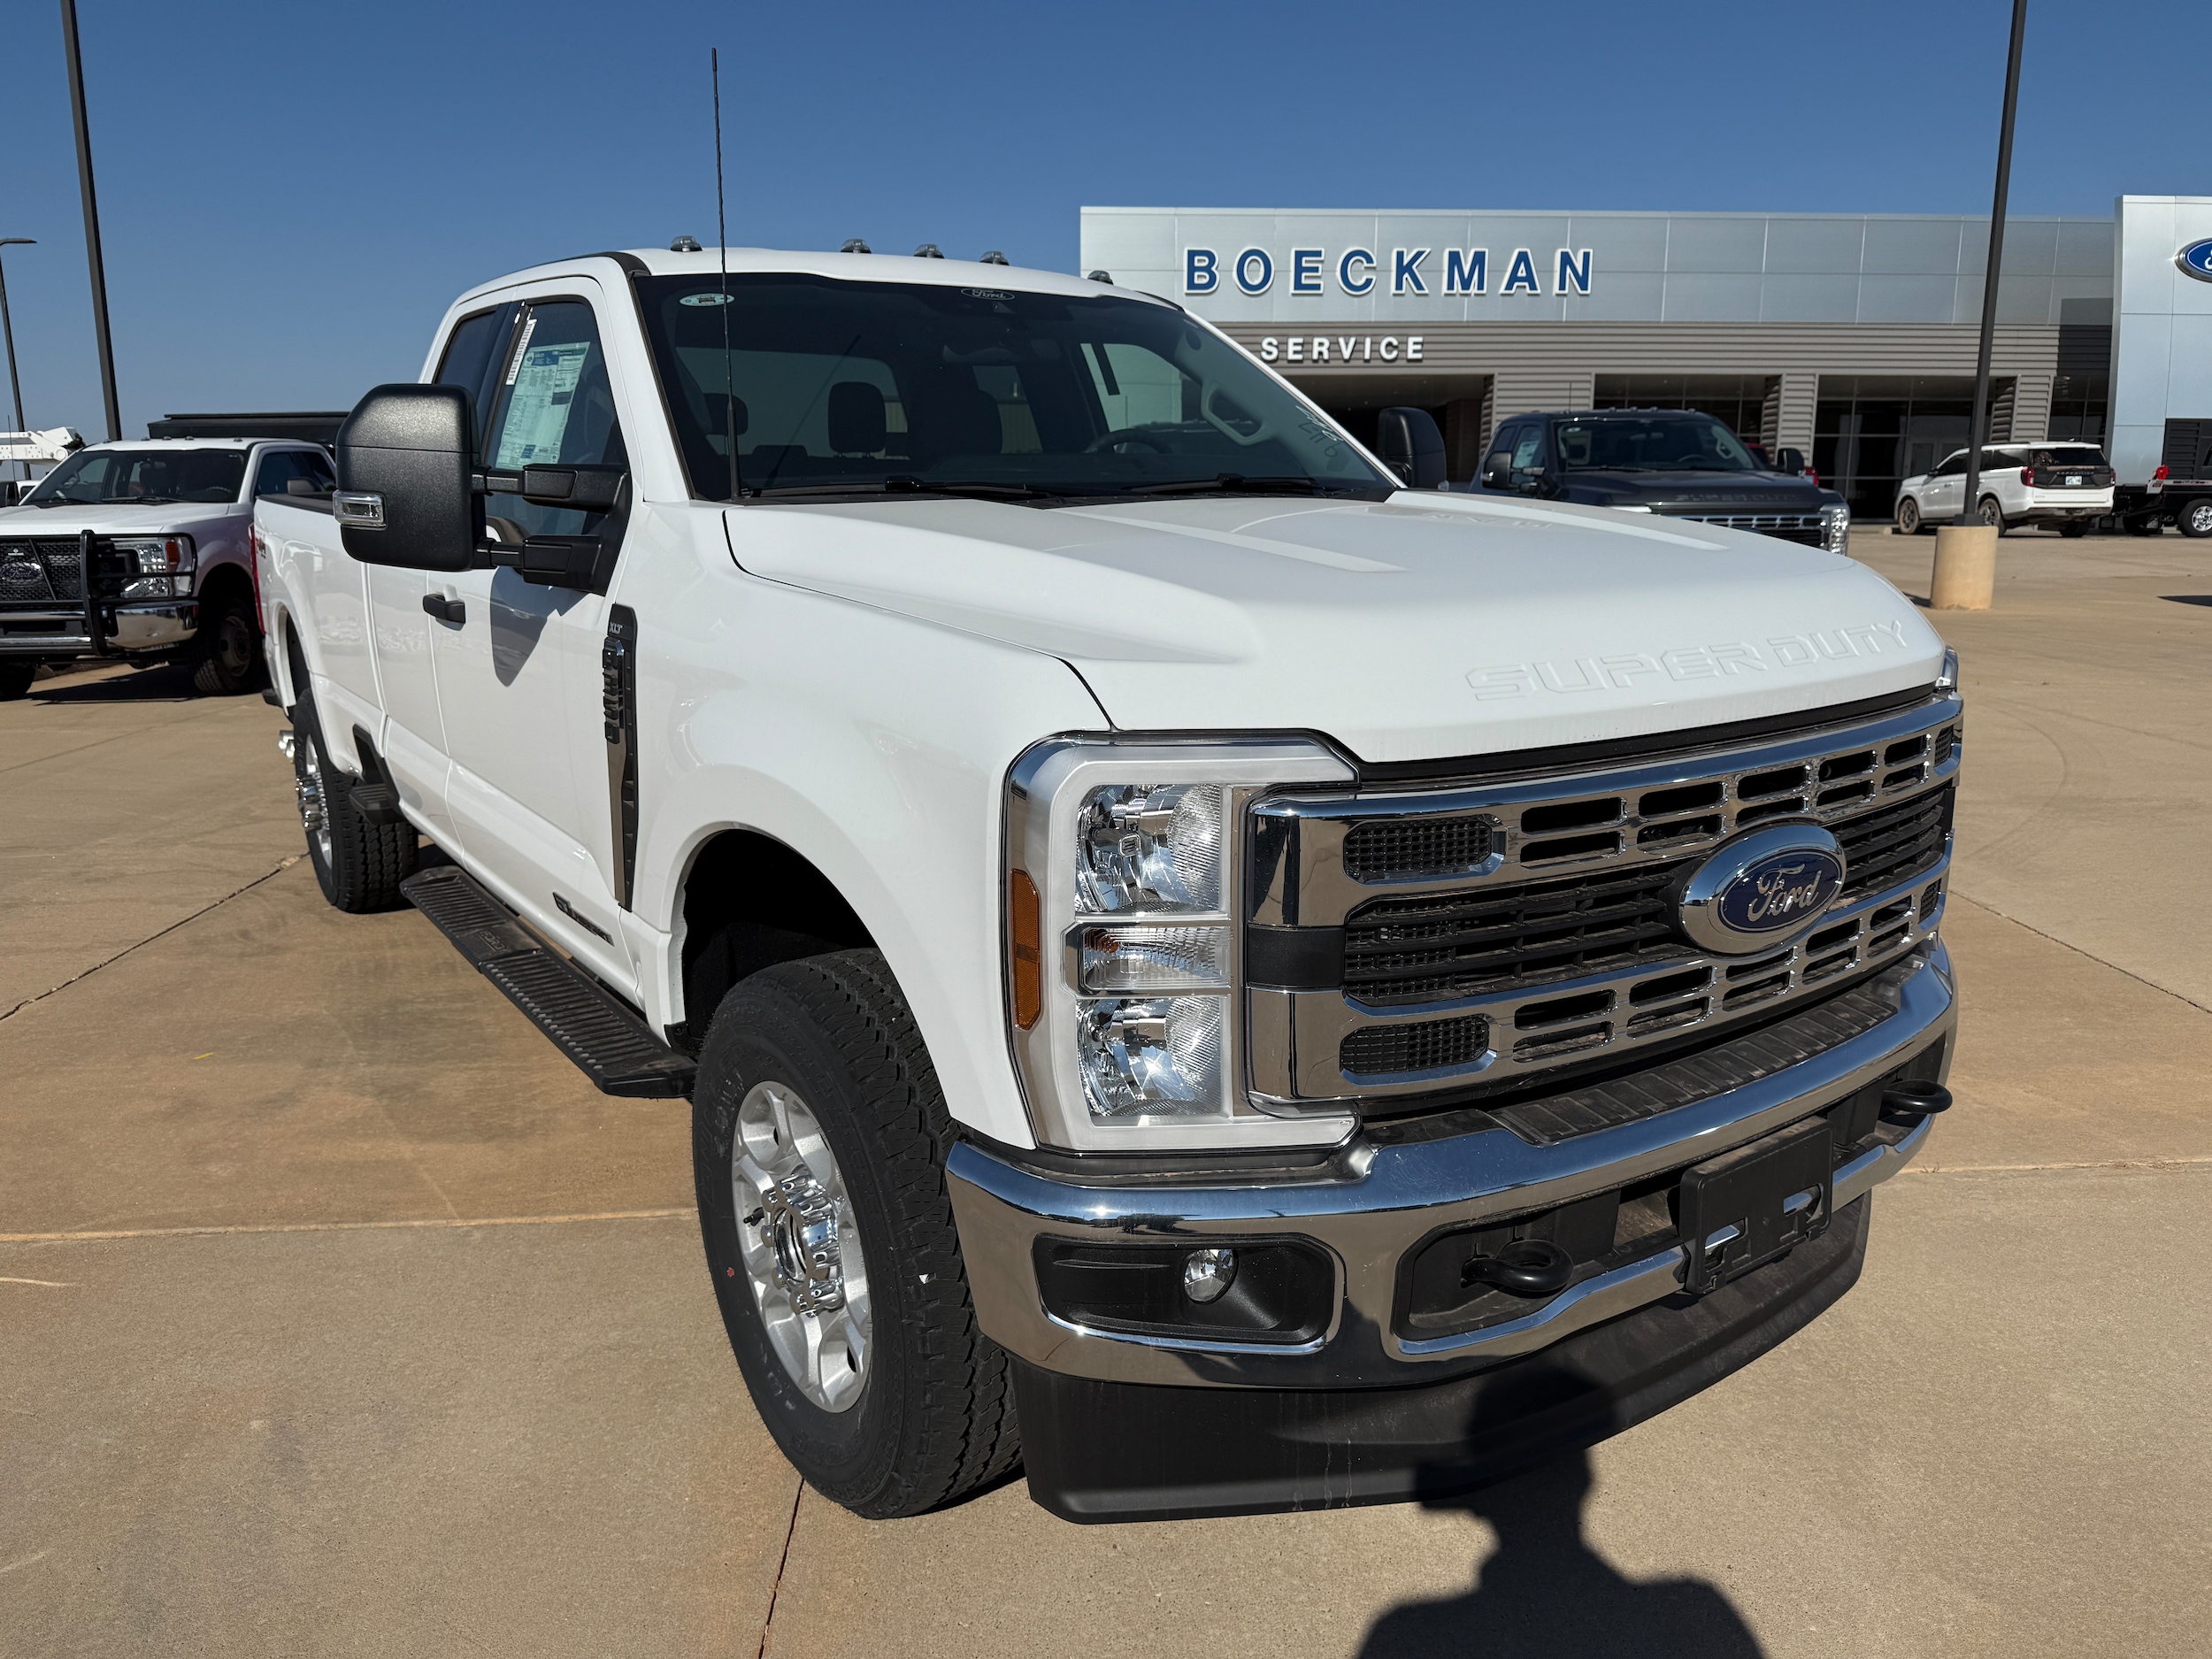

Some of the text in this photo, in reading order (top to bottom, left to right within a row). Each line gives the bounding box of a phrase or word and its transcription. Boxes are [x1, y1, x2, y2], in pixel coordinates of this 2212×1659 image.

[1183, 246, 1594, 296] BOECKMAN
[1259, 335, 1425, 363] SERVICE
[609, 622, 623, 634] XLT
[1464, 619, 1909, 701] SUPER DUTY
[1747, 863, 1823, 922] Ford
